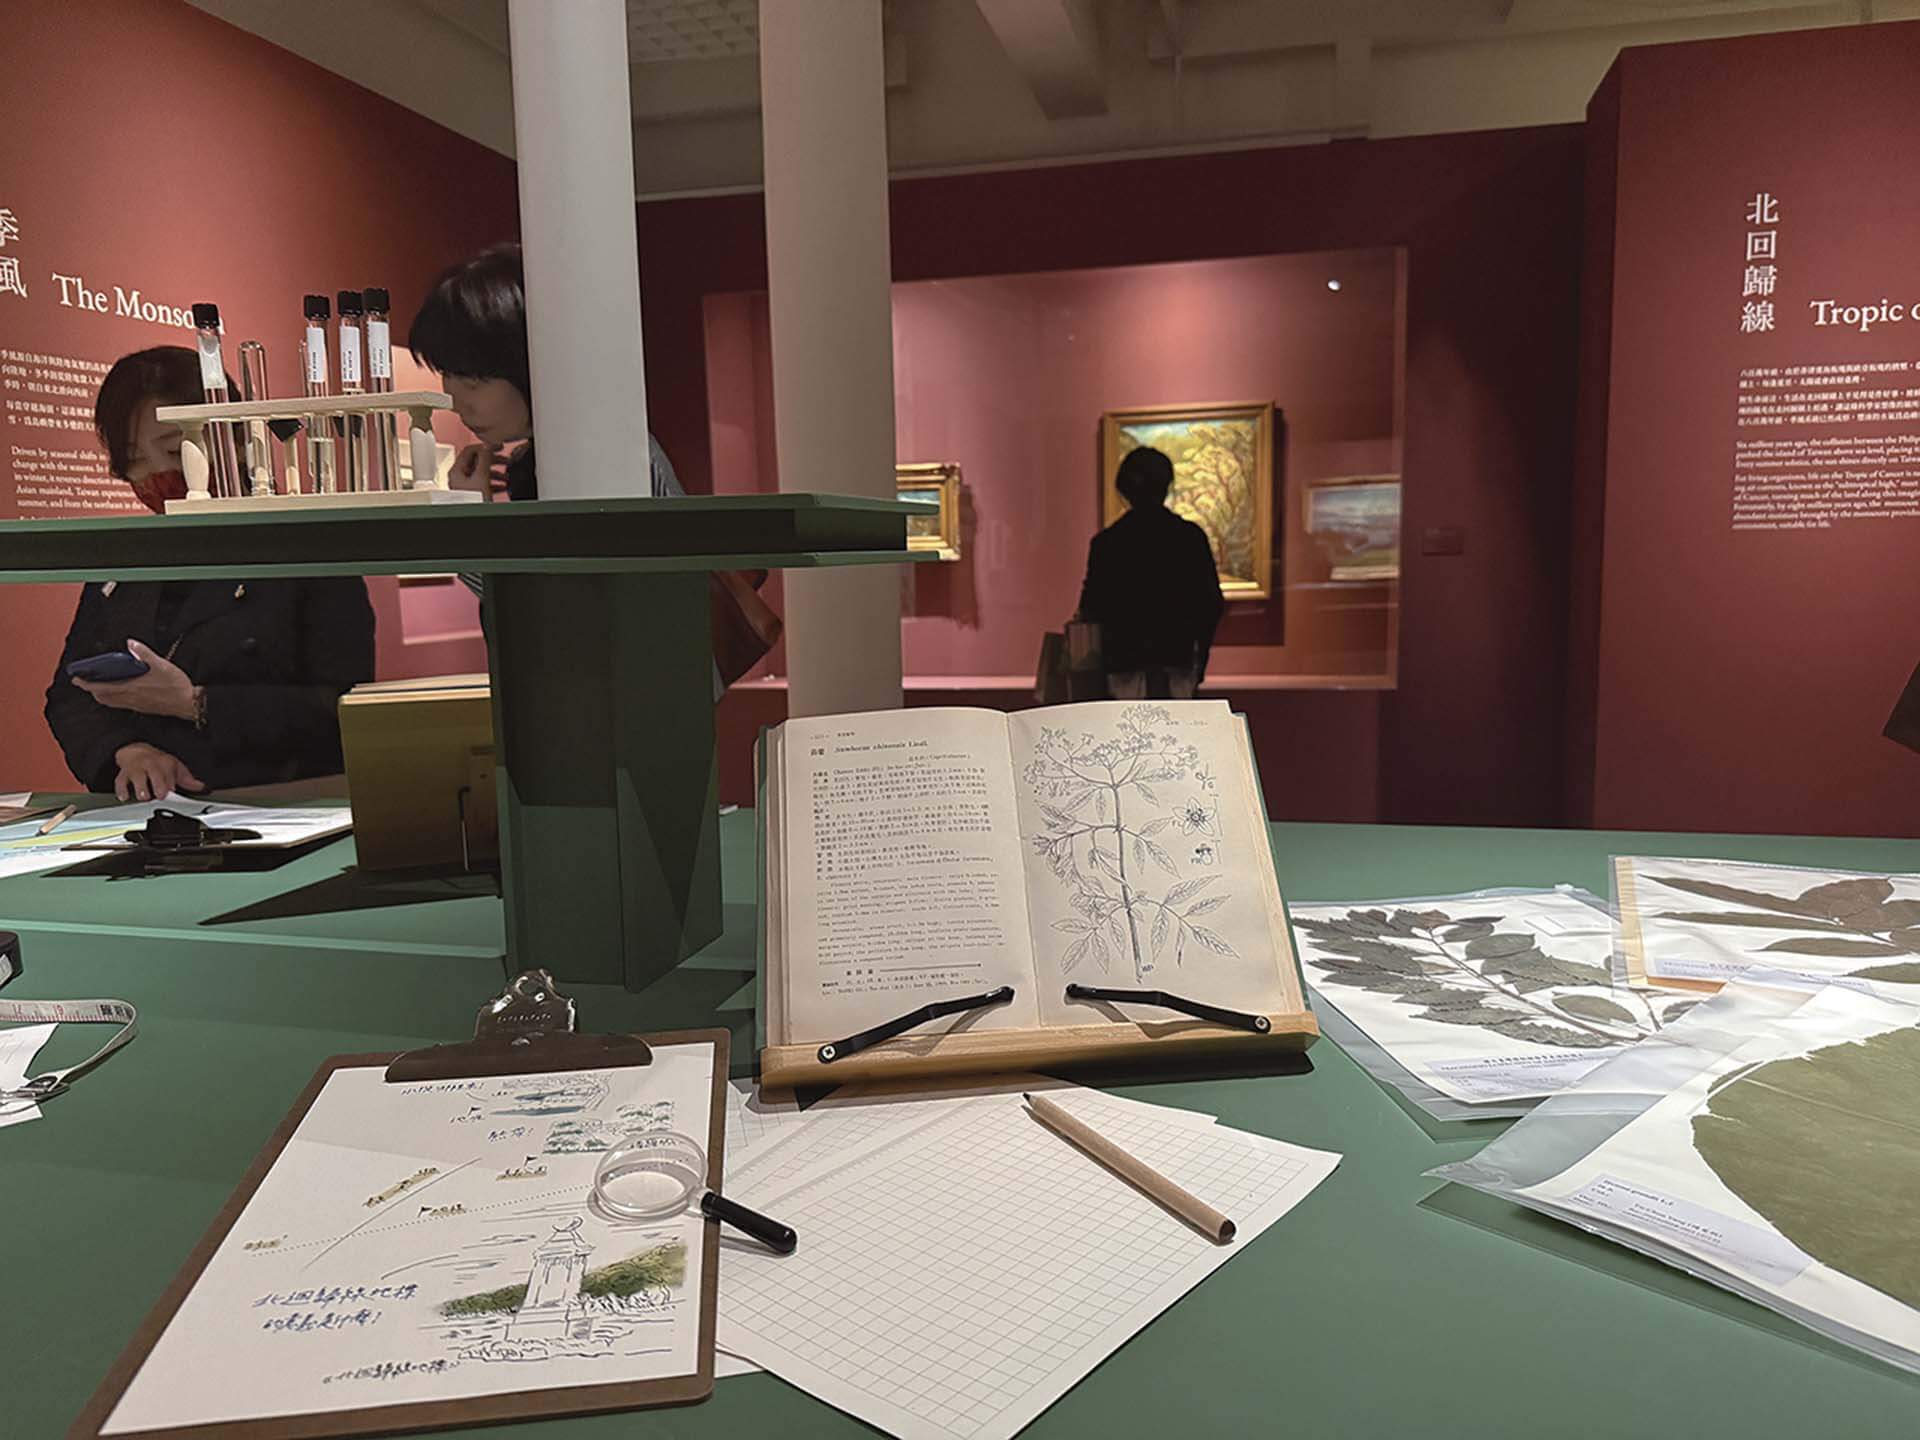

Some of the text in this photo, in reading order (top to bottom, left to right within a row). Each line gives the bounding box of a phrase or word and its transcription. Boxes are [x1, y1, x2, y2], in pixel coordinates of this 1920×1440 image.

[1740, 193, 1780, 333] 北回歸線
[52, 272, 225, 335] The Monso
[1809, 298, 1904, 332] Tropic
